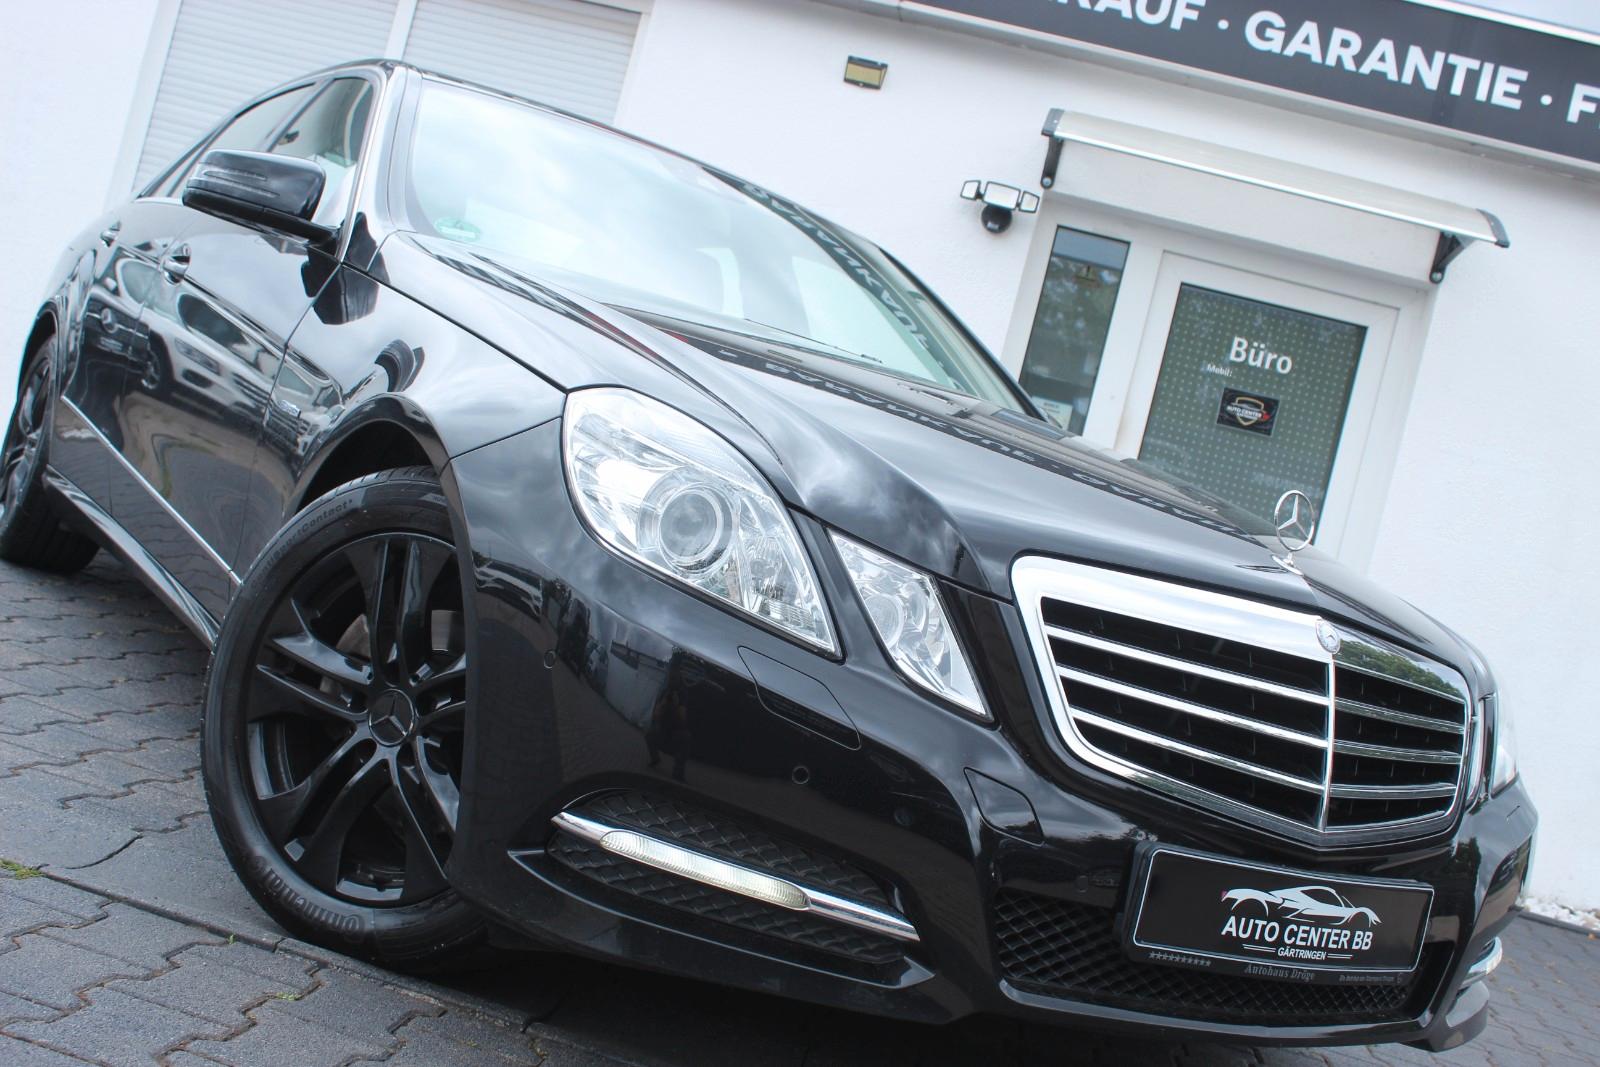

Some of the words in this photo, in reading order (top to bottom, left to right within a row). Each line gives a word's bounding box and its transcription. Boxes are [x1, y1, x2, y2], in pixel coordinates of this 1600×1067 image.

[1057, 0, 1206, 30] AUF
[1245, 11, 1528, 110] GARANTIE
[1229, 336, 1292, 374] Büro
[1221, 915, 1280, 942] AUTO
[1283, 924, 1350, 949] CENTER
[1352, 930, 1373, 950] BB
[1244, 963, 1289, 978] Autohaus
[1277, 946, 1327, 961] GÄRTRINGEN
